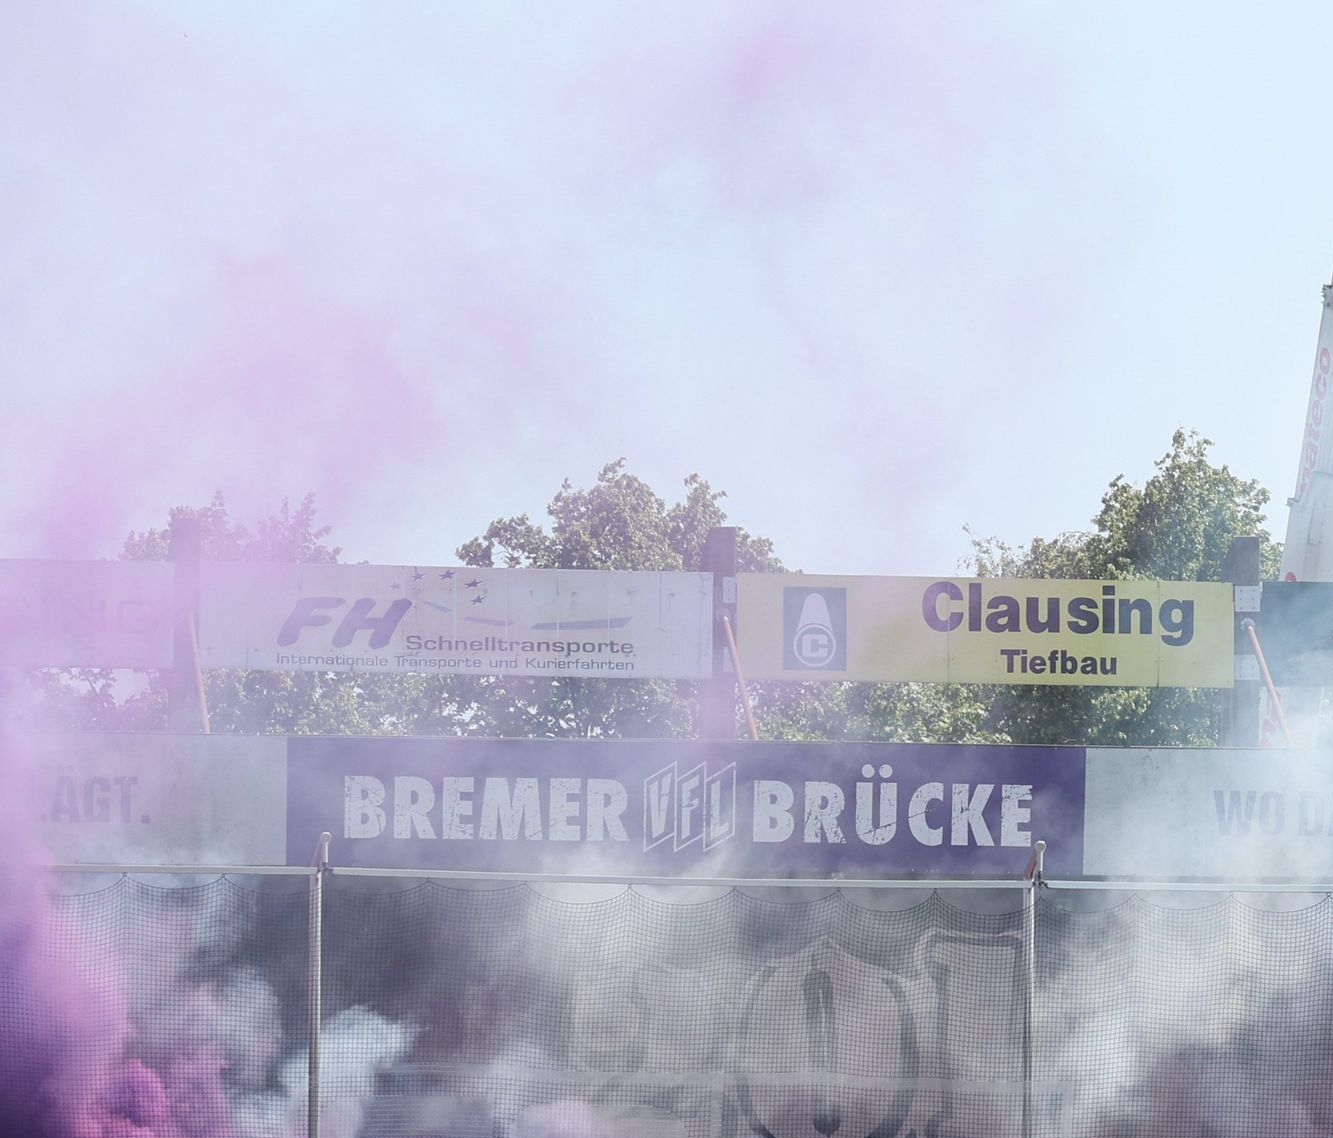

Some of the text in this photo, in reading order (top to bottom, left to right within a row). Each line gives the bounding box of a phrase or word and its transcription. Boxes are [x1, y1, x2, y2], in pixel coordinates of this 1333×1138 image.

[276, 597, 413, 650] FH
[922, 580, 1196, 648] Clausing
[276, 653, 635, 671] Internationale Transporte und Kurierfahrten
[405, 634, 635, 657] Schnelltransporte
[1000, 647, 1119, 677] Tiefbau
[343, 775, 629, 843] BREMER
[752, 764, 1032, 848] BRÜCKE
[1213, 789, 1287, 837] WO
